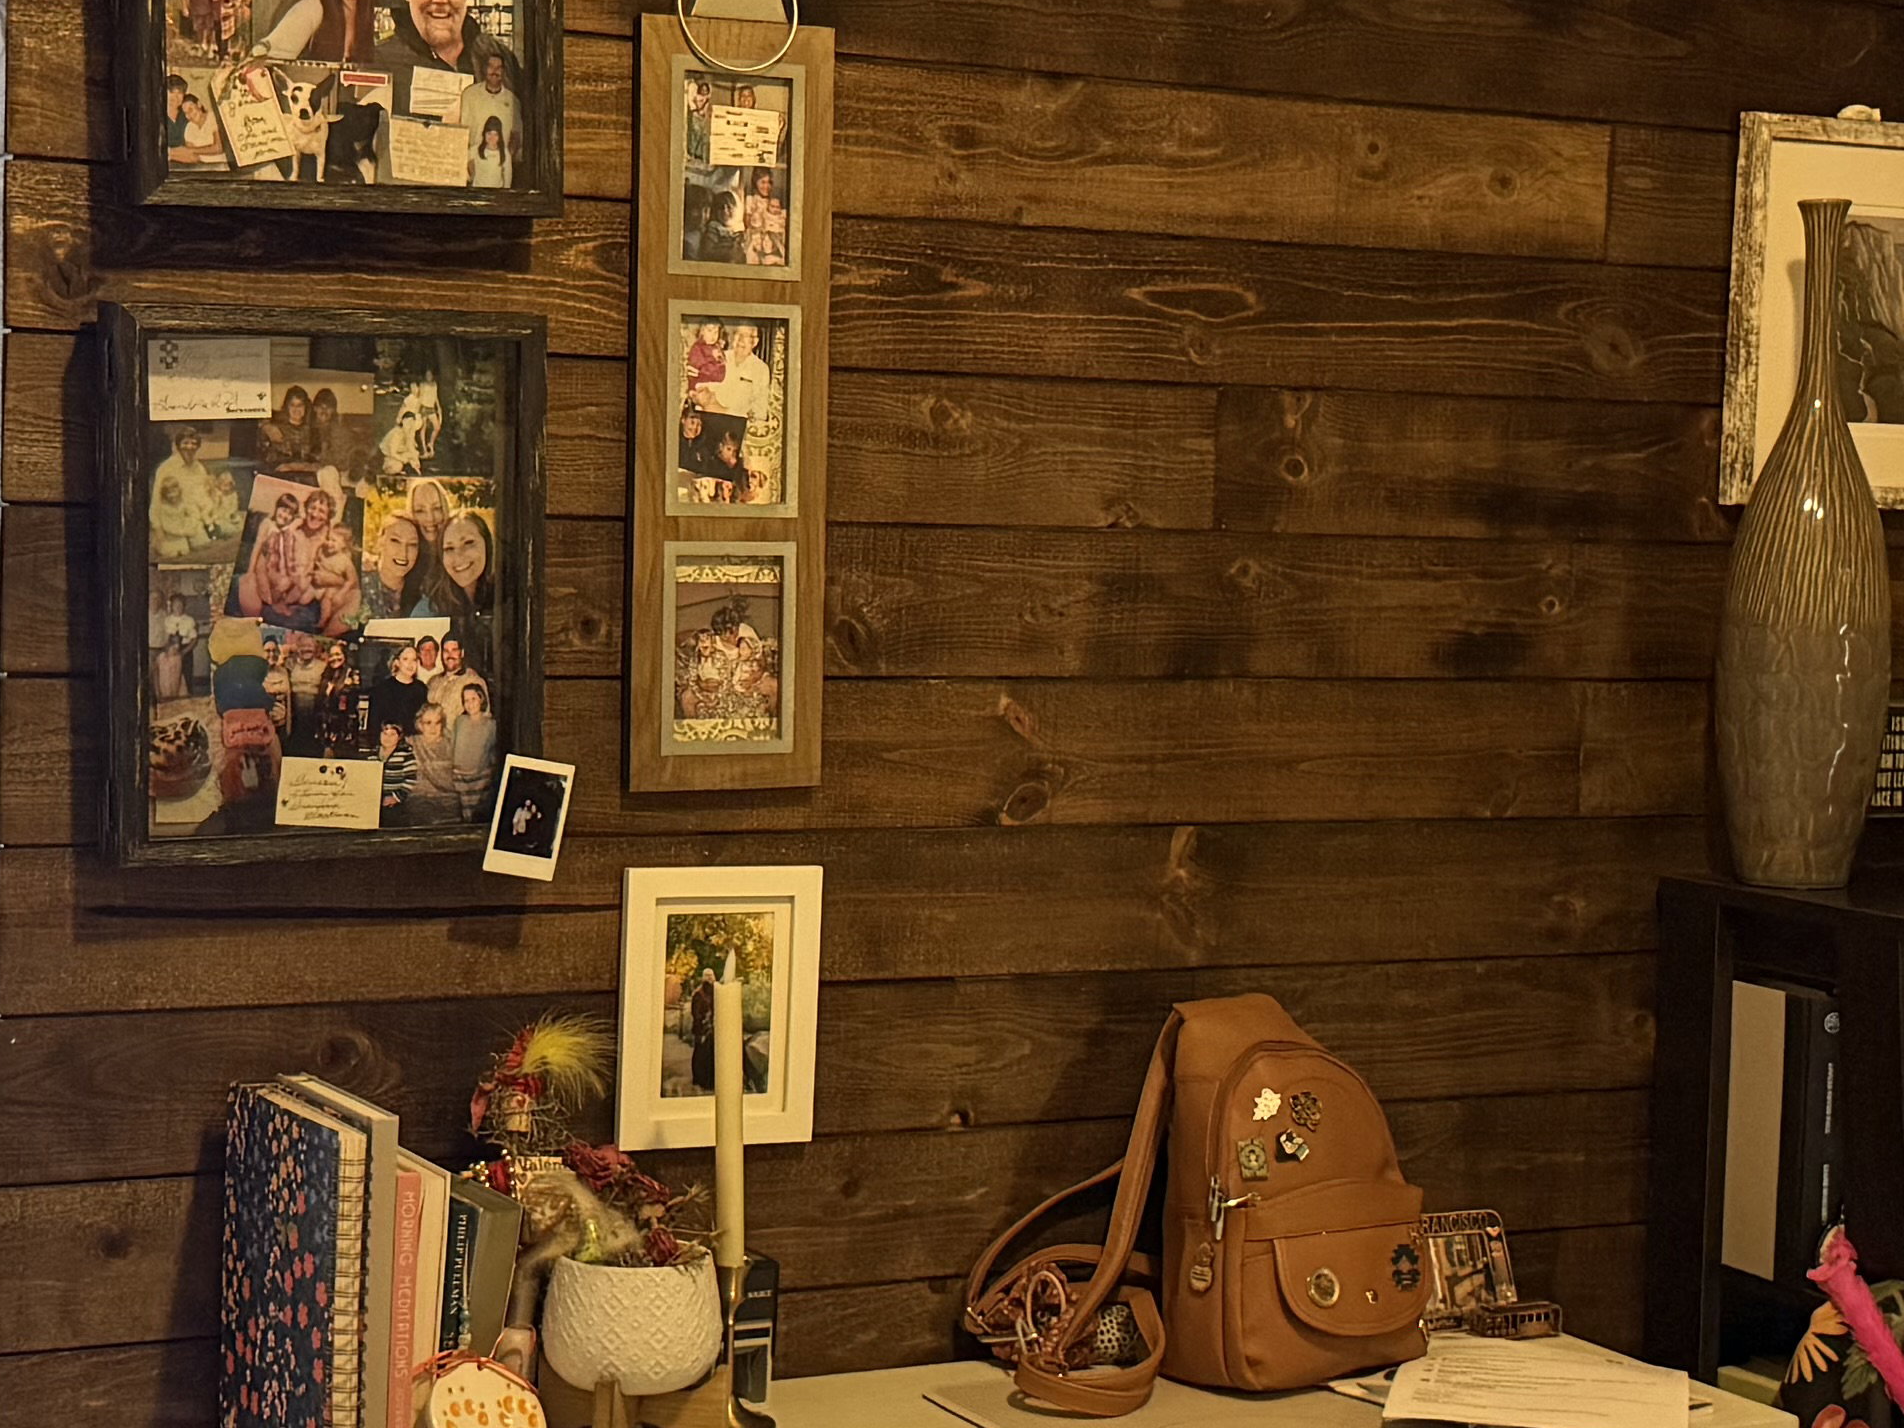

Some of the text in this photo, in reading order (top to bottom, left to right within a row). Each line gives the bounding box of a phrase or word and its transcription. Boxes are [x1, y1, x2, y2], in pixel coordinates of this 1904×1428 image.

[1895, 752, 1904, 769] TO
[1876, 771, 1892, 788] OUT
[1871, 789, 1892, 807] ANCE
[1893, 789, 1903, 807] IN
[518, 1156, 563, 1172] Valen
[399, 1190, 418, 1267] MORNING
[1422, 1214, 1488, 1233] RANCISCO
[455, 1214, 468, 1254] PHILIP
[448, 1257, 463, 1315] PULLMAN
[394, 1275, 413, 1379] MEDITATIONS
